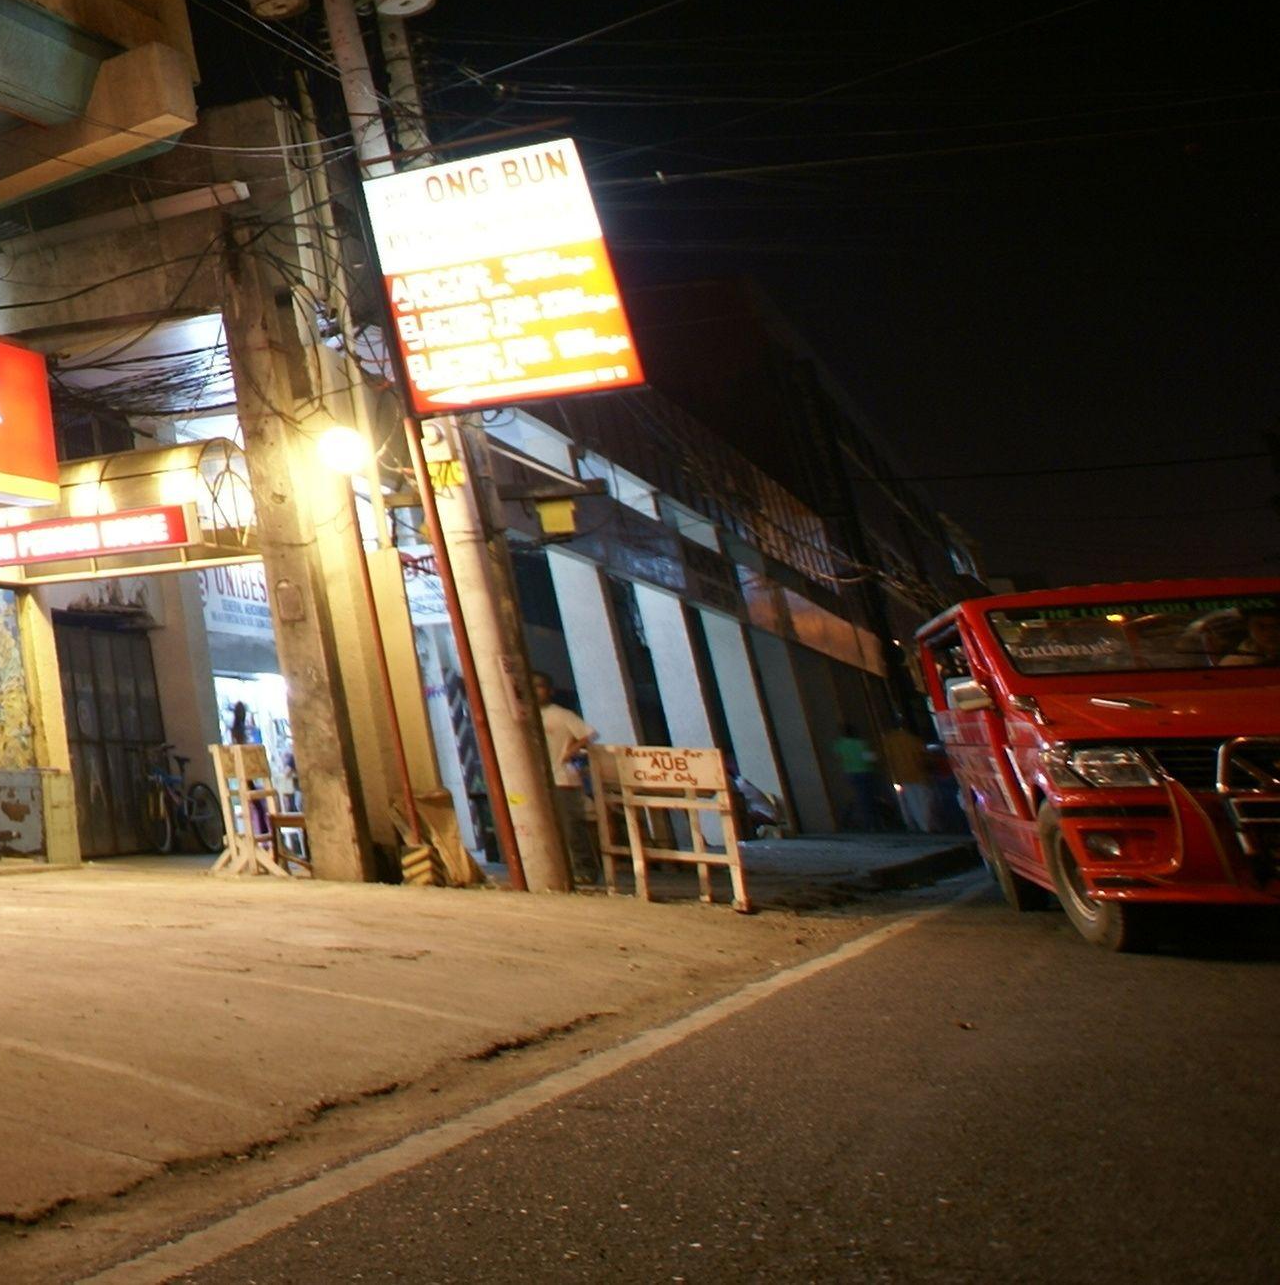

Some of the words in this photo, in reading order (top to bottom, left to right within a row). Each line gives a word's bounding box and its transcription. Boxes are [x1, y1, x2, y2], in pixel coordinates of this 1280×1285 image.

[425, 165, 490, 203] ONG
[500, 149, 571, 188] BUN
[650, 757, 689, 772] AUB
